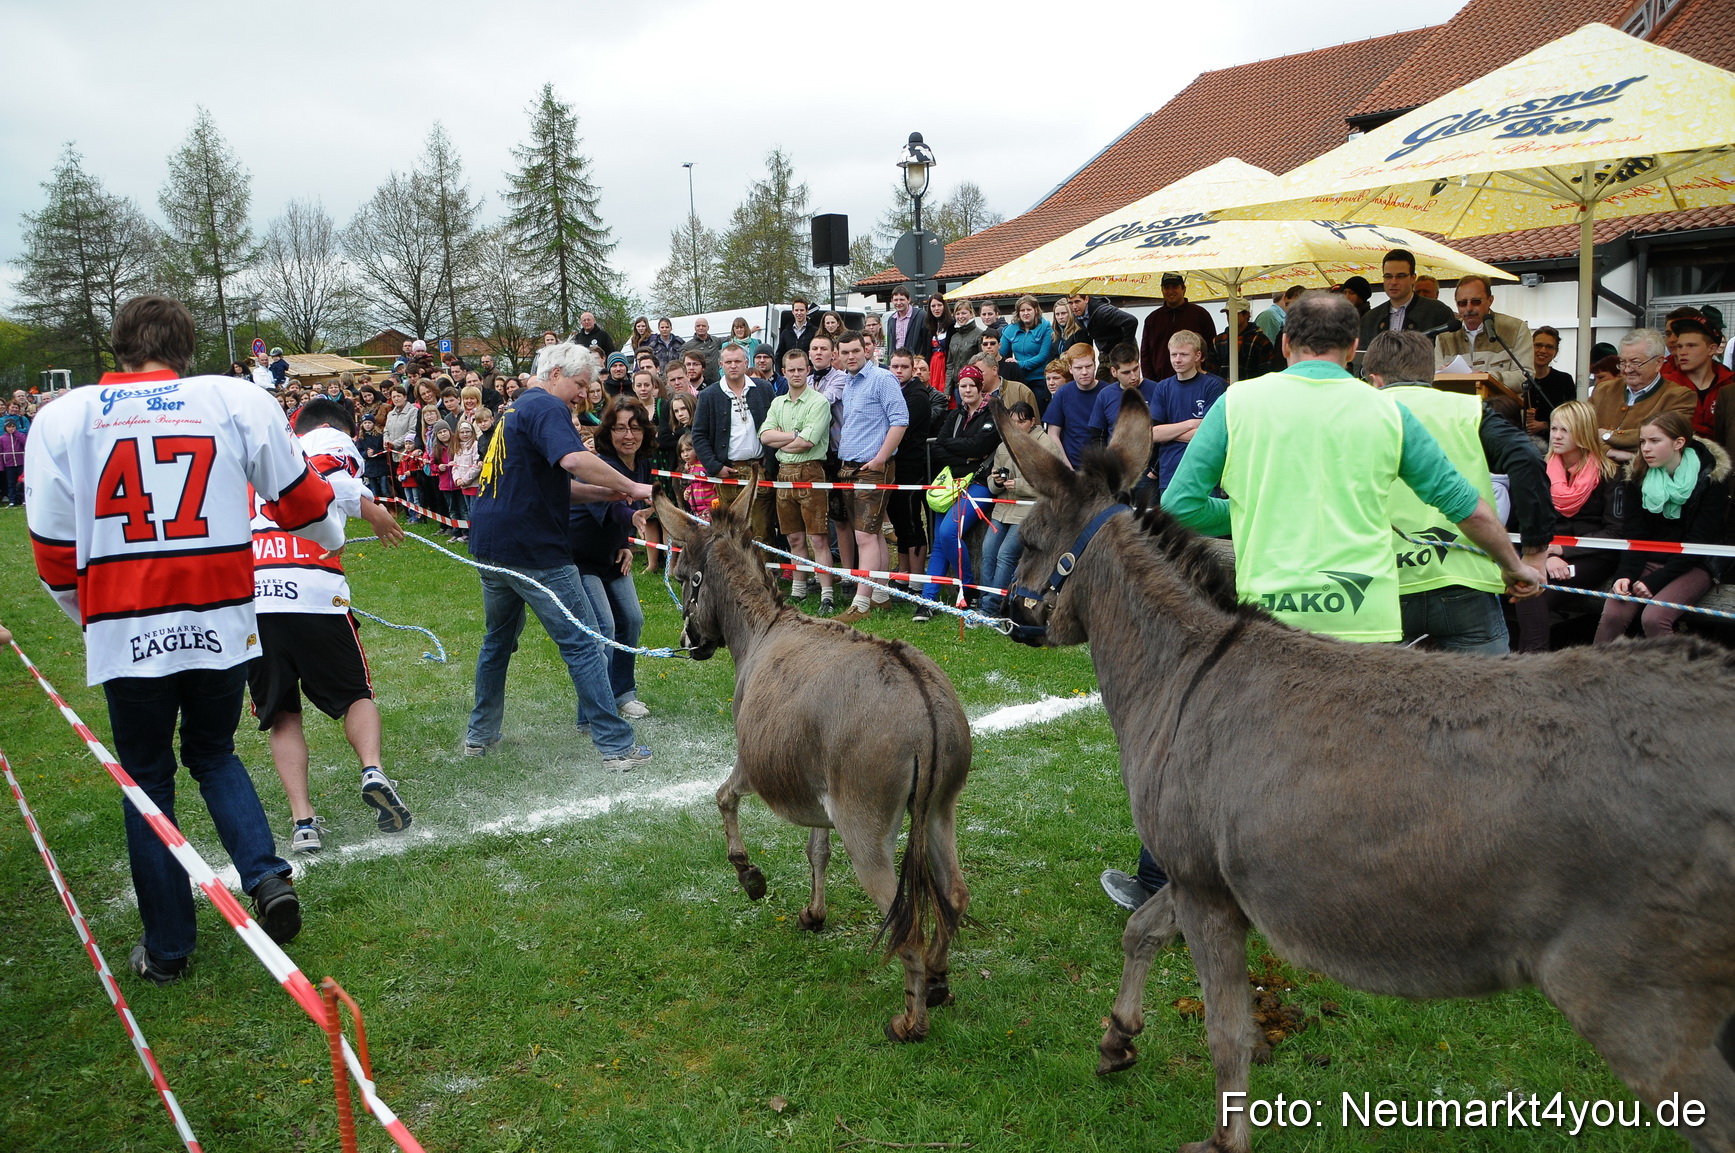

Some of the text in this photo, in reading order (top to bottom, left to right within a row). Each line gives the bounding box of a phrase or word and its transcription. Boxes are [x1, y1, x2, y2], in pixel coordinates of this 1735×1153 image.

[1385, 75, 1648, 162] Glossner
[1492, 115, 1614, 140] Bier
[1069, 212, 1219, 261] Glossn
[1134, 230, 1211, 249] Bier
[100, 383, 182, 416] Glossner
[146, 397, 185, 411] Bier
[93, 419, 111, 430] Der
[95, 434, 217, 544] 47
[252, 537, 310, 560] WAB L.
[1396, 547, 1432, 568] KO
[255, 581, 298, 600] GLES
[1259, 592, 1345, 613] JAKO
[144, 625, 202, 640] NEUMARKT
[130, 629, 223, 664] EAGLES
